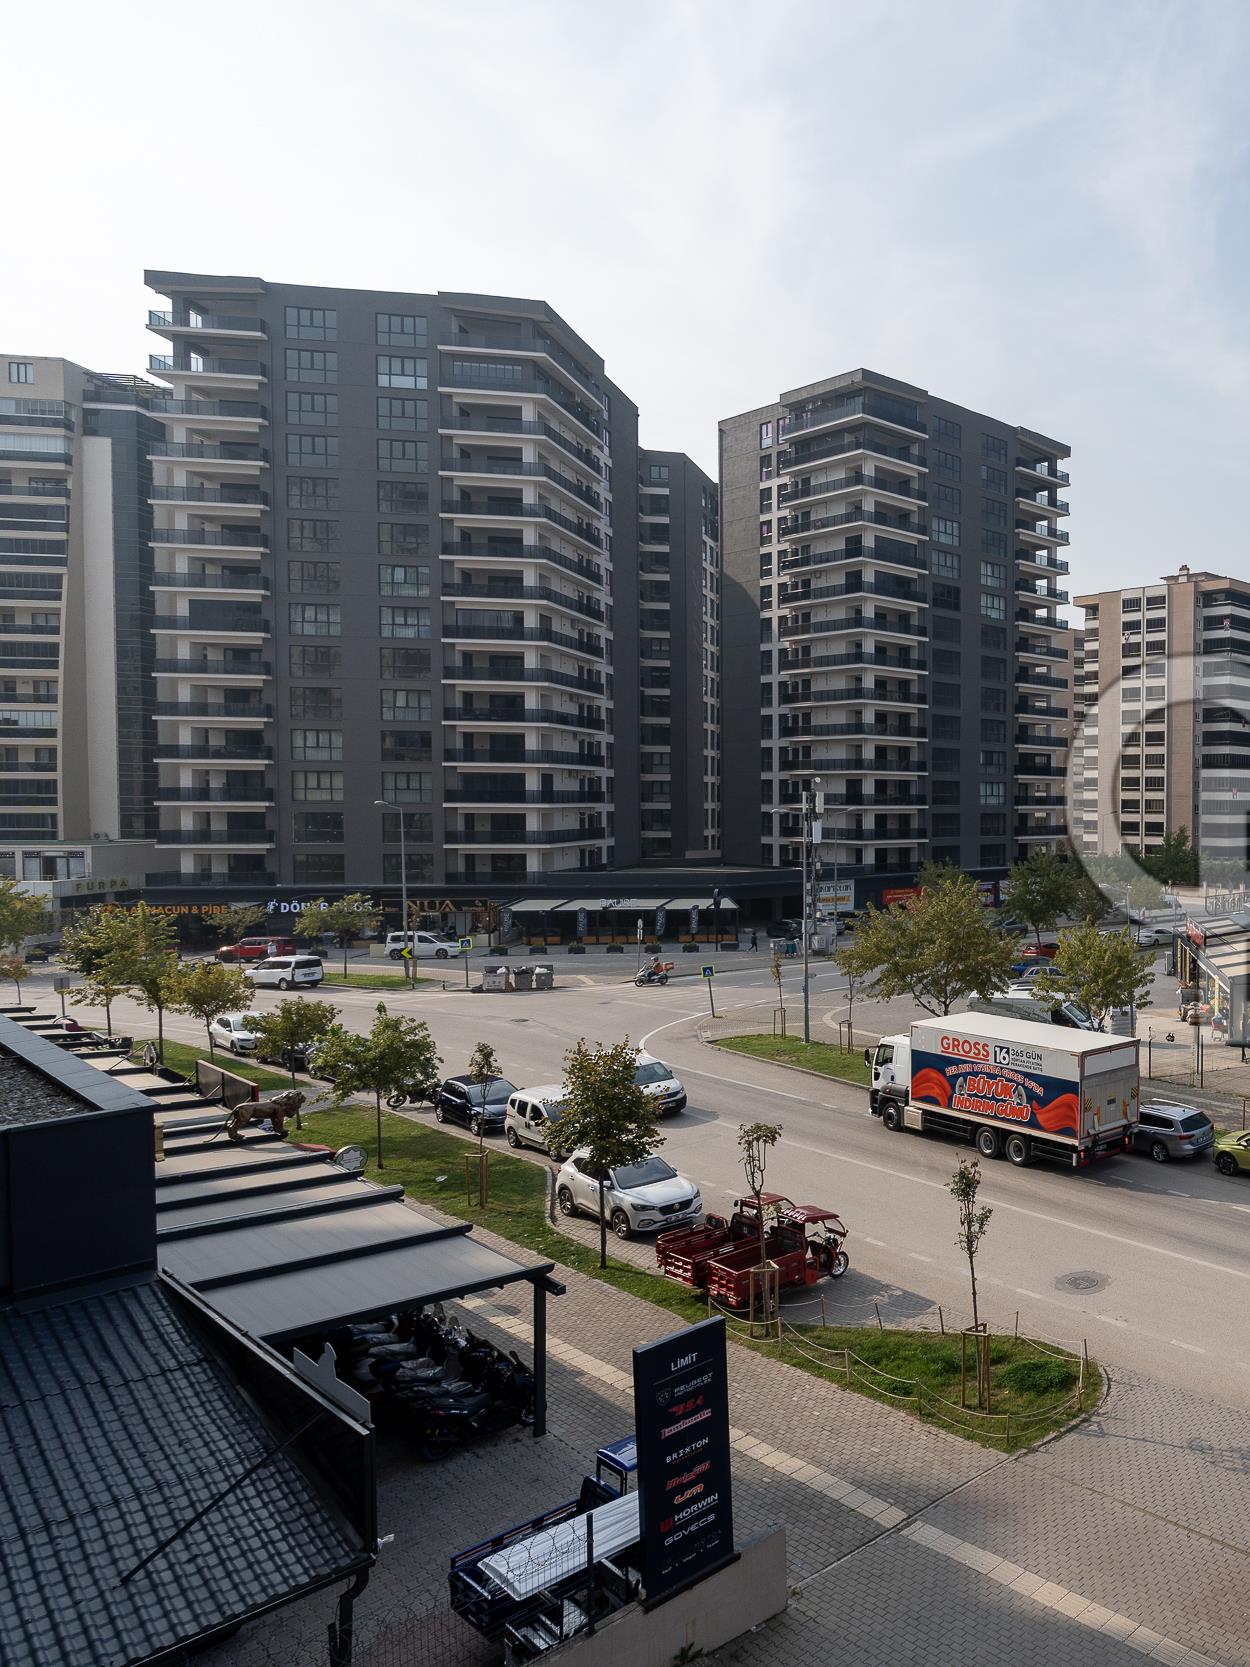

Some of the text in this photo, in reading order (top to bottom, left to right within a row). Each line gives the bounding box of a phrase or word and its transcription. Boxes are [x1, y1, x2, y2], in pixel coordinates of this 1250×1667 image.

[75, 879, 128, 893] FURPA
[123, 903, 228, 915] LAMACUN & PİDE
[280, 900, 329, 912] DÖNR
[940, 1035, 1010, 1065] GROSS 16
[1011, 1048, 1042, 1061] 365 GÜN
[944, 1065, 958, 1076] HER
[1001, 1068, 1024, 1083] GROSS
[966, 1074, 1017, 1099] BÜYÜK
[996, 1101, 1031, 1121] GÜNÜ
[674, 1372, 713, 1393] PEUGEOT
[665, 1437, 709, 1464] BRIXTON
[674, 1492, 718, 1522] HORWIN
[664, 1513, 715, 1546] GOVECS
